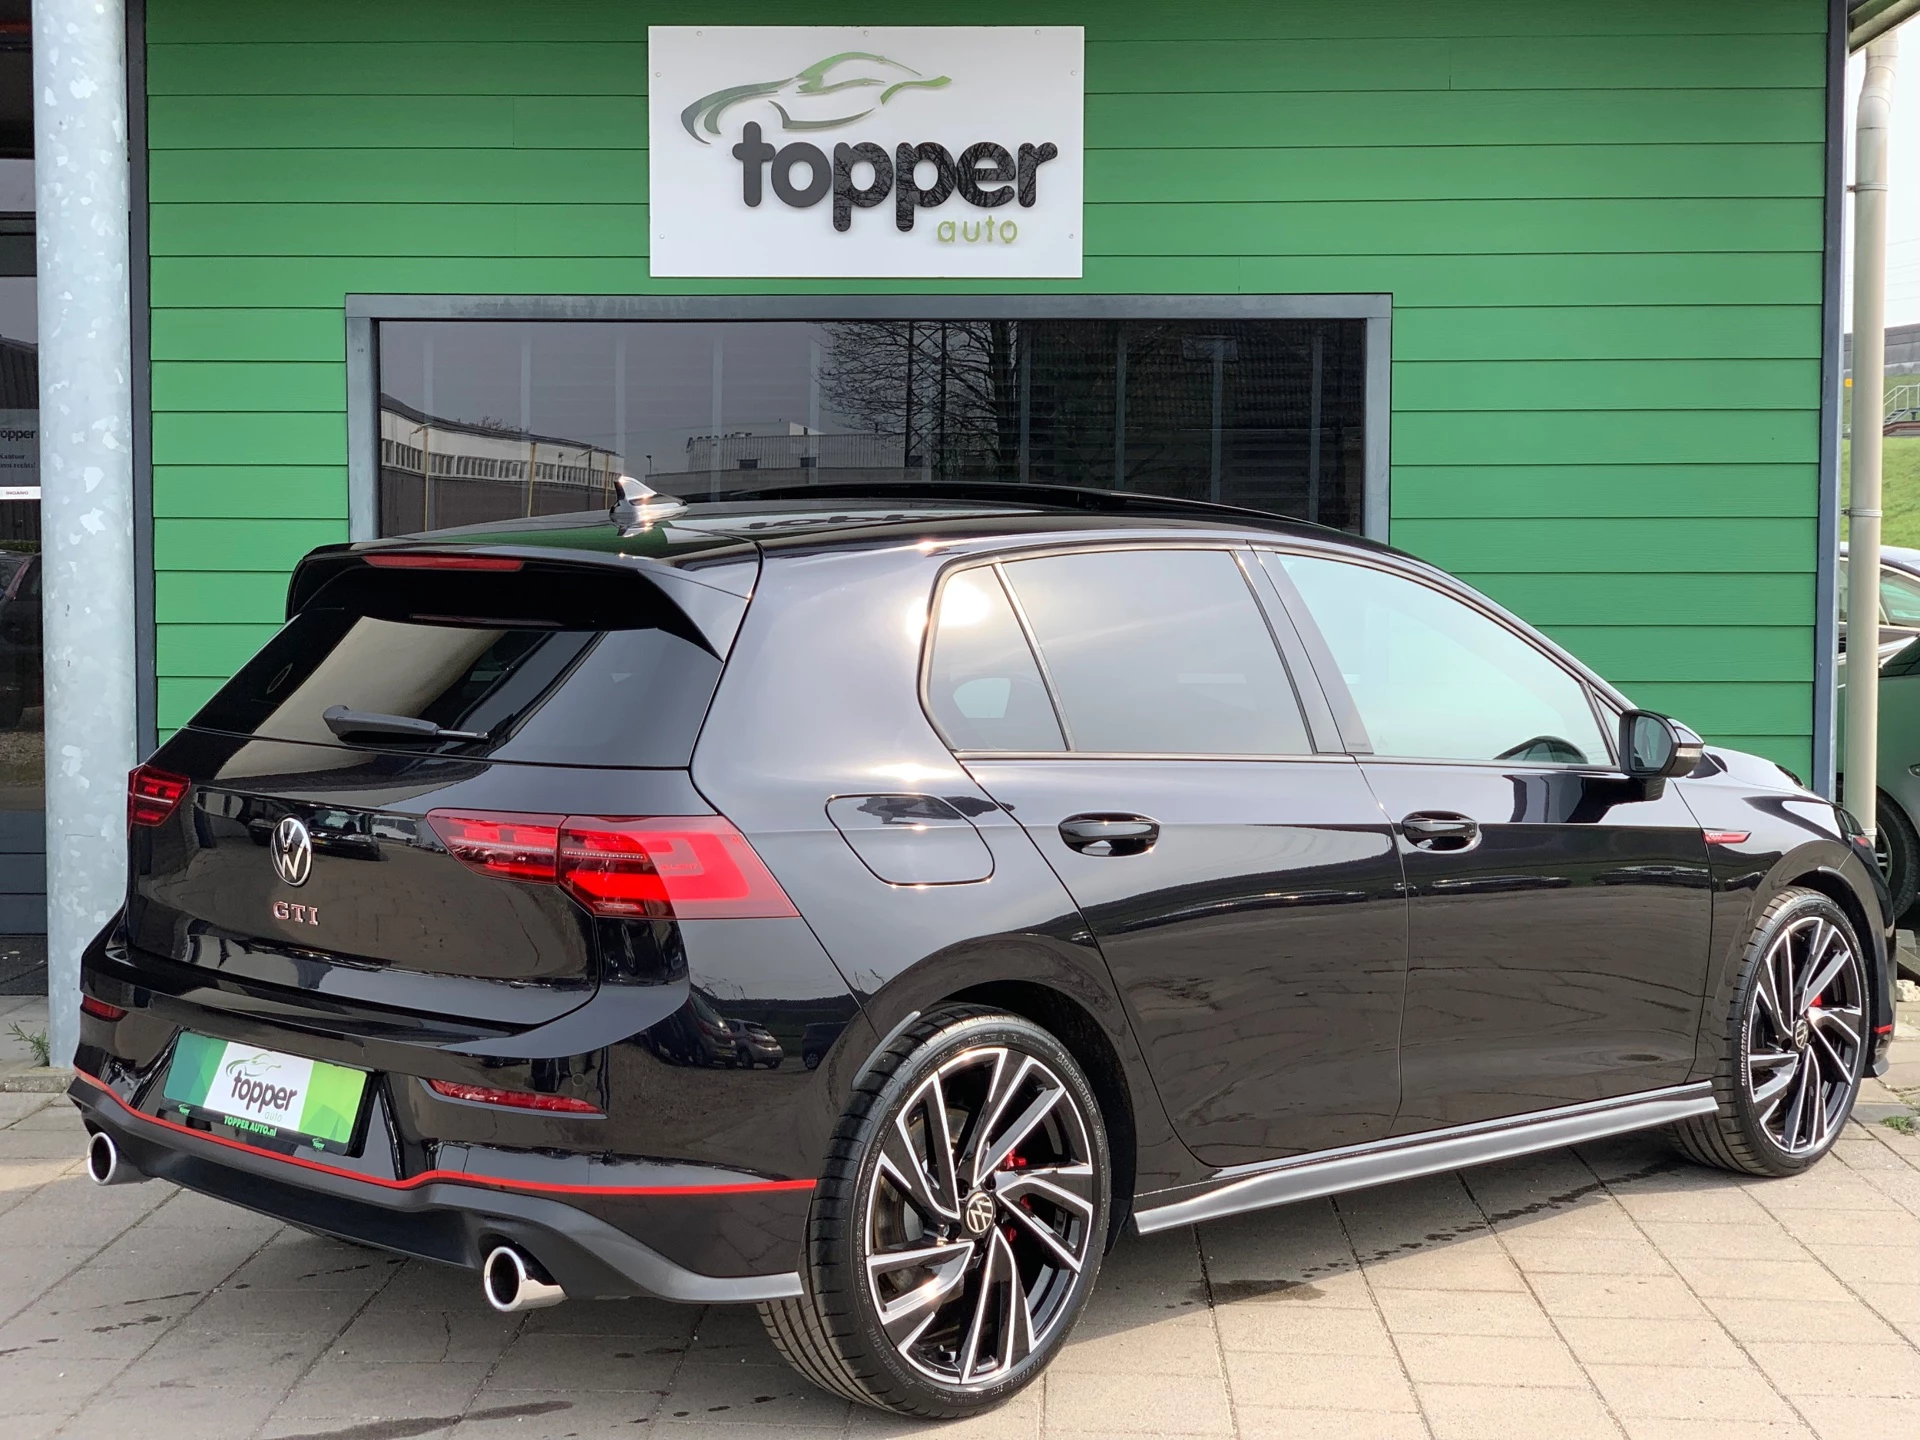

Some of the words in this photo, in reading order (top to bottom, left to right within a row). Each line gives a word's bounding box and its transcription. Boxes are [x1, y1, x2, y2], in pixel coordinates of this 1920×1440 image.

[732, 121, 1058, 232] topper
[937, 215, 1019, 244] auto
[0, 429, 36, 441] opper
[272, 901, 319, 926] GTI
[231, 1069, 298, 1113] topper
[223, 1114, 249, 1131] TOPPER
[249, 1122, 277, 1137] AUTO.nl
[264, 1111, 283, 1123] auto
